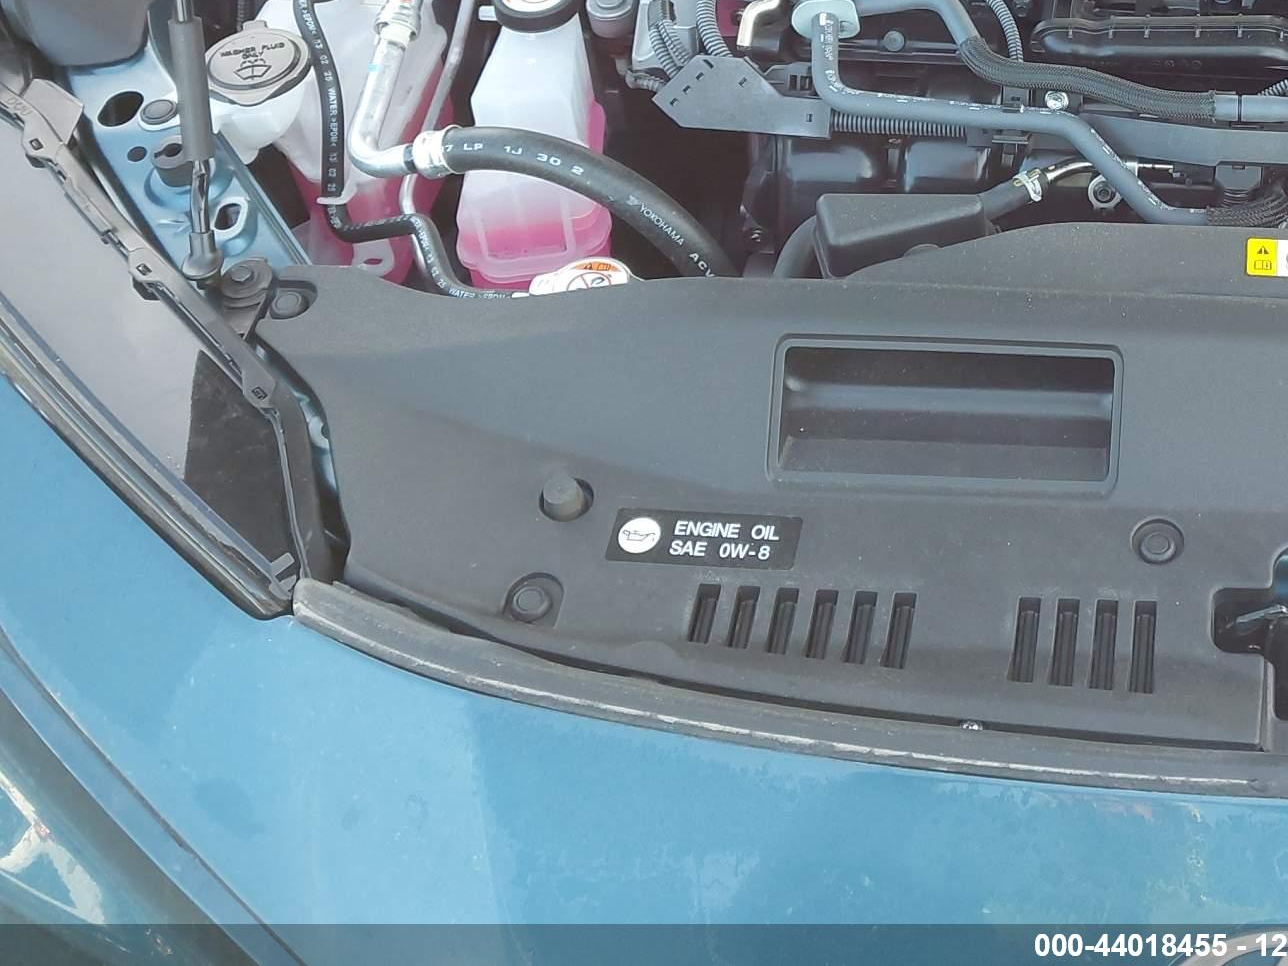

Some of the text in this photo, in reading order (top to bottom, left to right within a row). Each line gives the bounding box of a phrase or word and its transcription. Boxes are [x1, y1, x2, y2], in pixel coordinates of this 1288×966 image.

[221, 42, 285, 57] WASHER FLUID
[242, 51, 264, 59] ONLY
[327, 87, 339, 116] WATER
[463, 143, 484, 151] LP
[504, 146, 523, 155] 1J
[570, 165, 585, 176] 2
[639, 202, 715, 278] YOKOHAMA ACV
[674, 520, 780, 541] ENGINE OIL
[669, 540, 770, 561] SAE 0W-8
